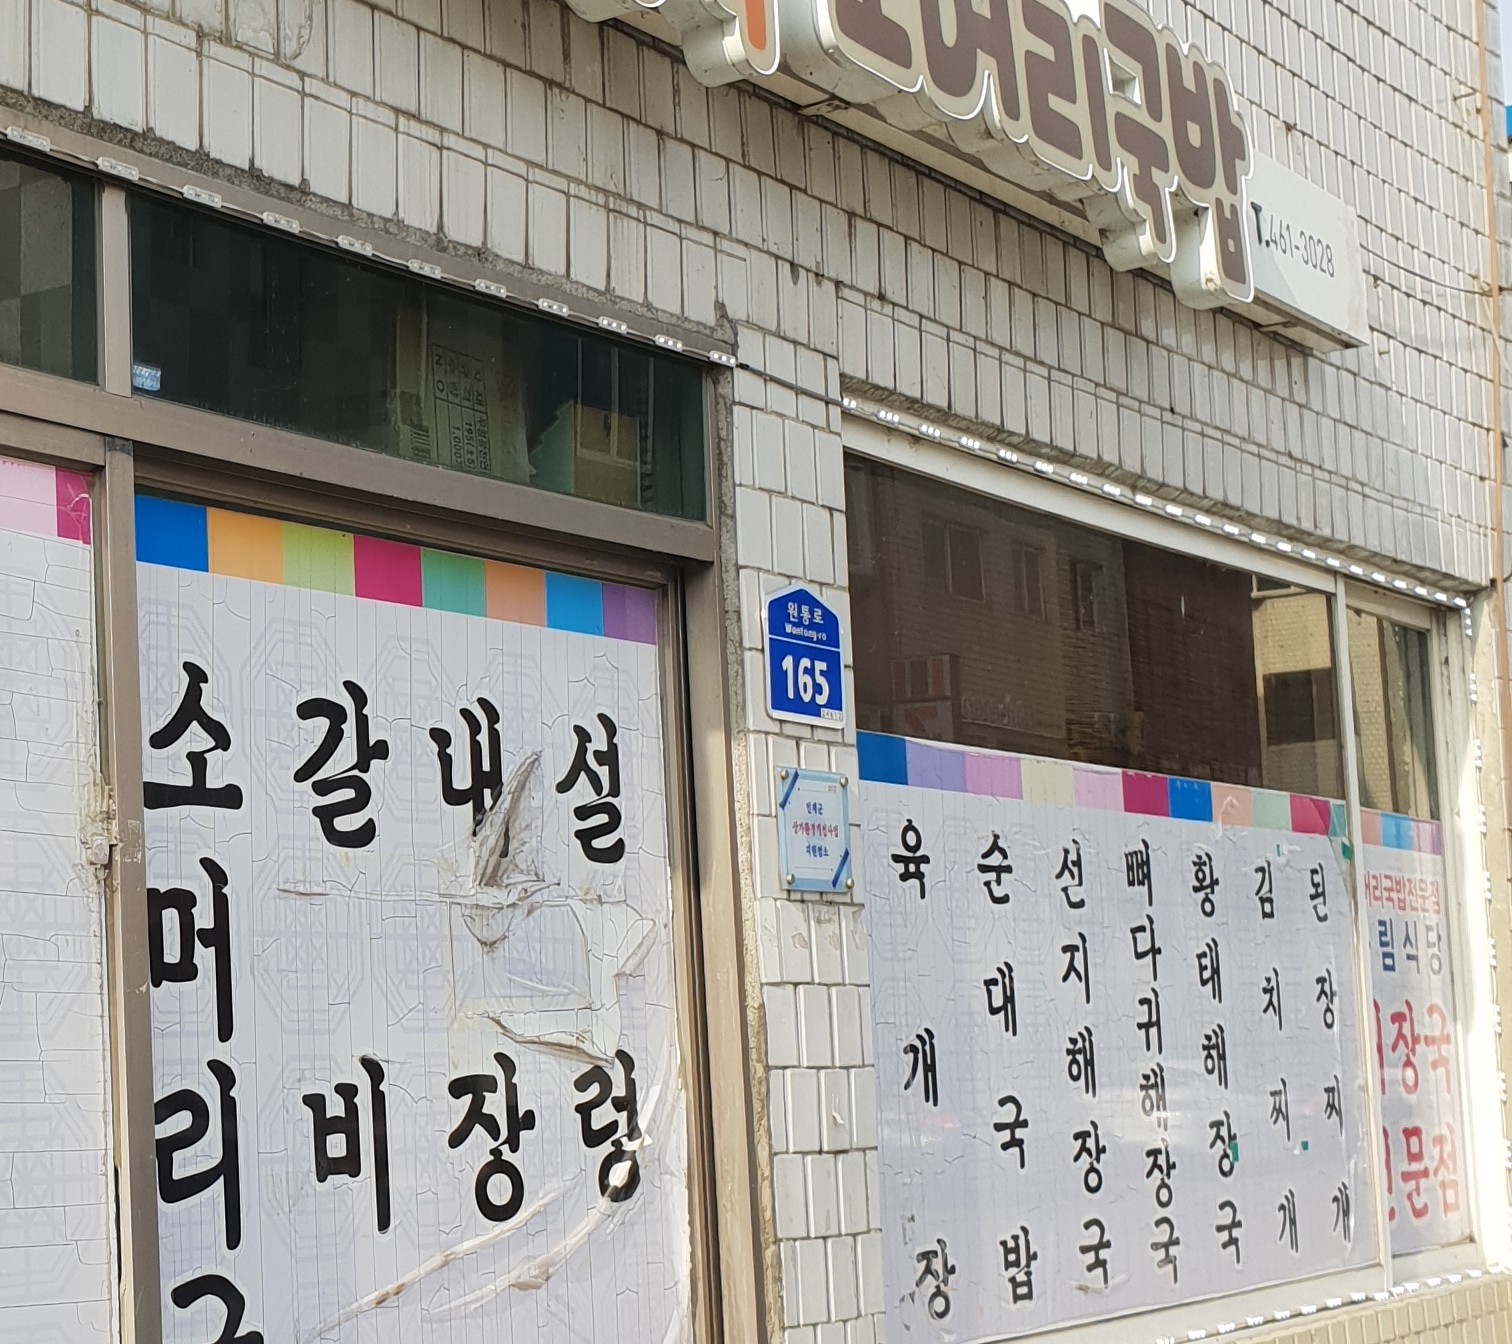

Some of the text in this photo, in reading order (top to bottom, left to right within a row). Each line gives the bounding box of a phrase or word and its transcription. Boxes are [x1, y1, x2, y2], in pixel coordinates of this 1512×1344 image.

[781, 654, 830, 706] 165
[787, 602, 824, 625] 원통로
[891, 819, 956, 1320] 육개장
[977, 833, 1037, 1304] 순대국밥
[1055, 839, 1111, 1289] 선지해장국
[1125, 839, 1181, 1284] 뼈다귀해장국
[1192, 852, 1242, 1264] 황태해장국
[1254, 859, 1299, 1253] 김치찌개
[1308, 862, 1351, 1242] 된장찌개
[1369, 918, 1442, 975] 림식당
[1373, 998, 1452, 1096] 장국
